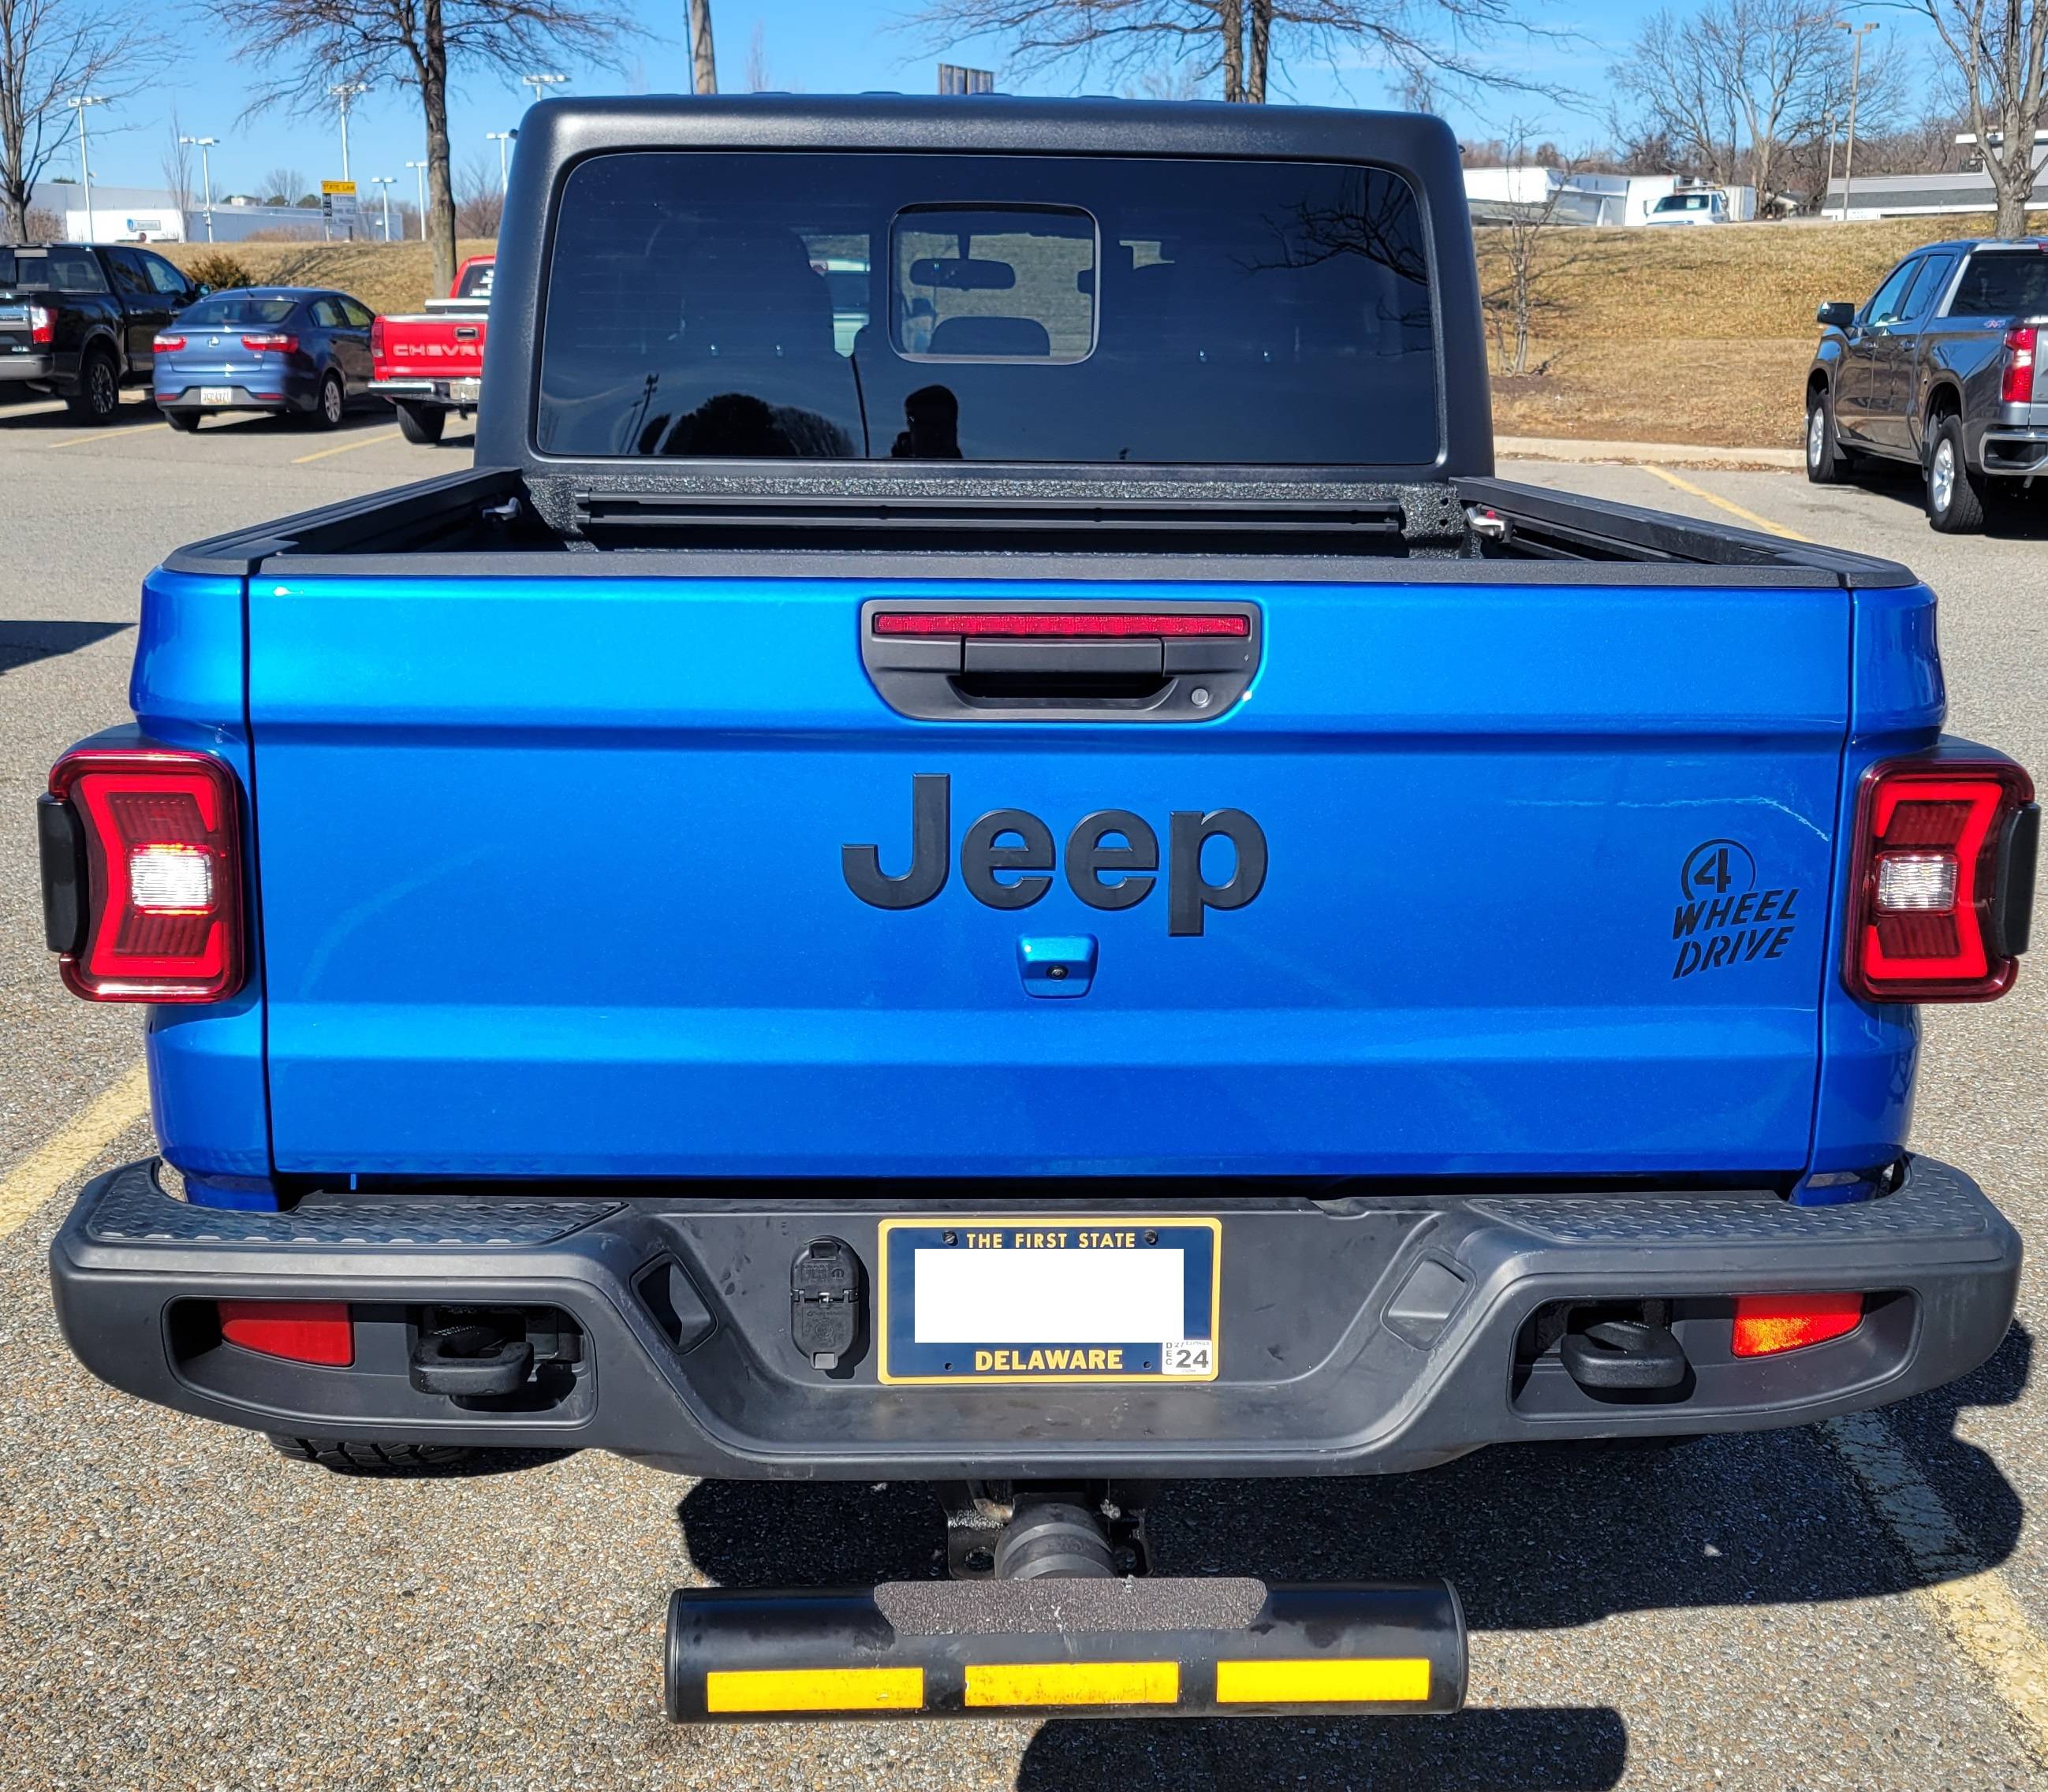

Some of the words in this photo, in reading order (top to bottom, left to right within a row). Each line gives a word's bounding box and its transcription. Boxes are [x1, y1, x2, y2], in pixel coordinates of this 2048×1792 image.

[841, 773, 1268, 937] Jeep
[1693, 848, 1732, 894] 4
[1672, 888, 1800, 940] WHEEL
[1672, 926, 1796, 980] DRIVE
[966, 1233, 1003, 1249] THE
[1014, 1232, 1068, 1249] FIRST
[1078, 1232, 1136, 1248] STATE
[974, 1349, 1123, 1372] DELAWARE
[1175, 1349, 1209, 1369] 24
